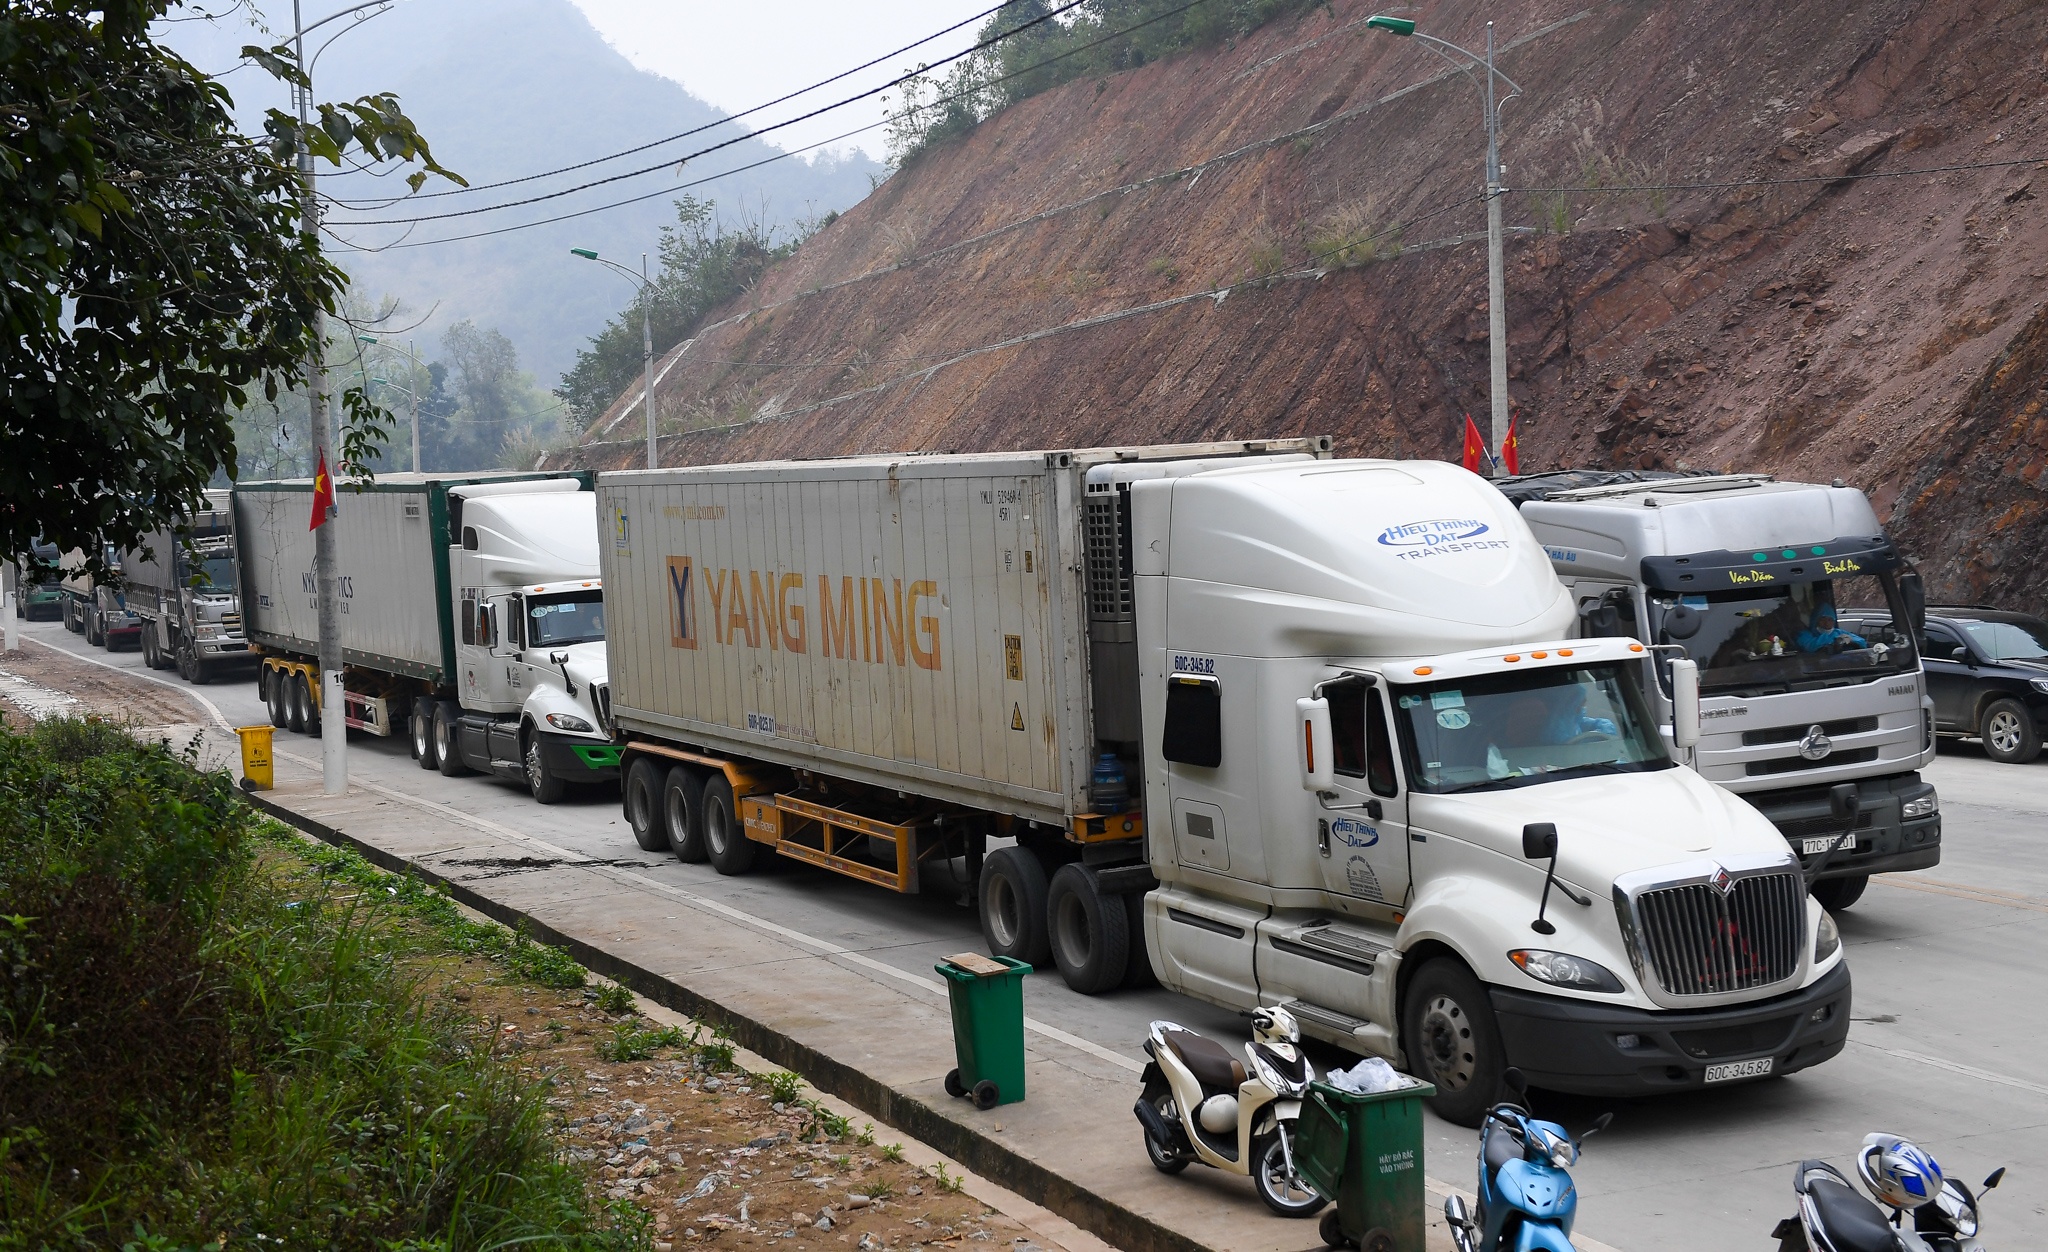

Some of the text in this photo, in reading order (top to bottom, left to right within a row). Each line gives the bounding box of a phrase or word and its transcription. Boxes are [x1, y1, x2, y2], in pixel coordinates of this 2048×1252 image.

[1396, 540, 1510, 560] TRANSPORT
[1822, 559, 1861, 574] Bình An
[302, 572, 317, 594] NYK
[1729, 571, 1750, 584] Vạn
[703, 567, 942, 671] YANG MING
[1174, 655, 1215, 673] 60C-345.82
